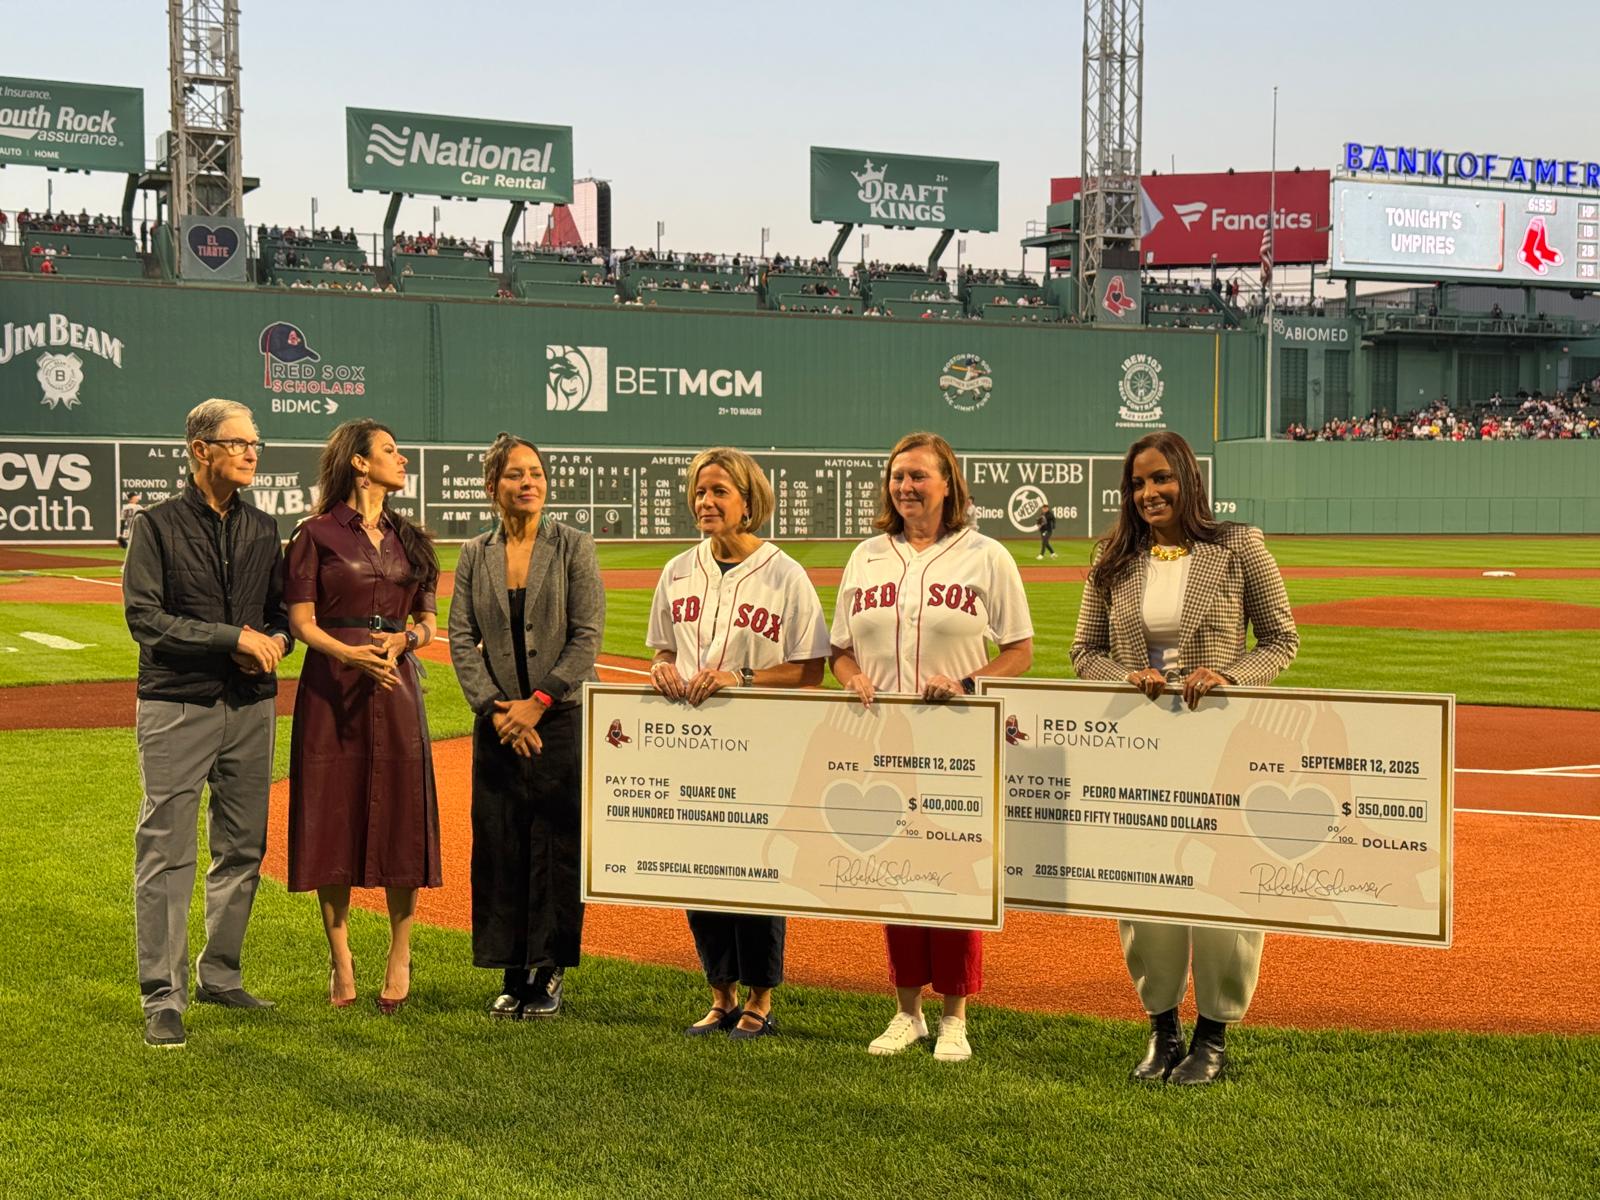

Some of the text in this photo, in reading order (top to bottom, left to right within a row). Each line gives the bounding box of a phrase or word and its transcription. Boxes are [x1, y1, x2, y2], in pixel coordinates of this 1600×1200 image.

[56, 106, 117, 134] Rock
[37, 130, 118, 147] assurance
[0, 148, 60, 159] AUTO HOME
[410, 131, 552, 173] National
[1345, 142, 1444, 178] BANK
[1456, 152, 1501, 180] OF
[461, 171, 547, 190] Car Rental
[858, 180, 948, 204] DRAFT
[870, 199, 946, 223] KINGS
[1528, 198, 1552, 212] 6:55
[1211, 207, 1312, 231] Fanatics
[1385, 208, 1463, 230] TONIGHT'S
[207, 235, 218, 246] EL
[1390, 233, 1456, 255] UMPIRES
[0, 313, 122, 369] JIM BEAM
[1284, 327, 1348, 342] ABIOMED
[1121, 354, 1162, 373] IBEW 103
[272, 363, 365, 381] RED SOX
[272, 380, 365, 396] SCHOLARS
[615, 366, 763, 398] BETMGM
[271, 399, 321, 414] BIDMC
[730, 407, 739, 416] TO
[740, 408, 762, 417] WAGER
[148, 448, 165, 458] AL
[178, 465, 187, 475] W
[443, 465, 630, 476] P 7 8 9 10 R H E
[825, 459, 873, 468] NATIONAL
[0, 452, 92, 491] CVS
[640, 467, 647, 476] P
[780, 469, 787, 478] P
[827, 469, 834, 478] R
[846, 470, 852, 478] P
[973, 462, 1084, 484] F.W. WEBB
[122, 478, 168, 489] TORONTO
[275, 475, 298, 487] BUT
[656, 480, 670, 488] CIN
[793, 481, 809, 490] COL
[858, 481, 874, 490] LAD
[146, 491, 171, 501] YORK
[453, 490, 487, 500] BOSTON
[655, 488, 671, 497] ATH
[861, 491, 871, 499] SF
[654, 498, 672, 507] CWS
[795, 499, 807, 508] PIT
[859, 500, 874, 509] TEX
[1017, 498, 1039, 518] WEBB
[1214, 501, 1237, 513] 379
[442, 511, 568, 521] AT BAT OUT
[654, 508, 672, 516] CLE
[792, 509, 810, 518] WSH
[858, 509, 874, 518] NYM
[976, 506, 1078, 519] Since 1866
[655, 517, 671, 526] BAL
[795, 518, 807, 526] KC
[858, 518, 874, 527] DET
[654, 527, 672, 535] TOR
[795, 526, 808, 535] PHI
[860, 526, 873, 535] MIA
[852, 582, 978, 616] RED SOX
[734, 603, 783, 643] SOX
[645, 722, 712, 736] RED SOX
[1043, 719, 1119, 734] RED SOX
[645, 736, 748, 752] FOUNDATION
[1043, 733, 1158, 750] FOUNDATION
[828, 755, 976, 772] DATE SEPTEMBER 12, 2025
[1249, 755, 1420, 775] DATE SEPTEMBER 12, 2025
[605, 775, 670, 788] PAY TO THE
[1027, 775, 1071, 787] TO THE
[613, 785, 737, 800] ORDER OF SQUARE ONE
[1009, 785, 1240, 807] ORDER OF PEDRO MARTINEZ FOUNDATION
[908, 797, 980, 813] $ 400,000.00
[1341, 801, 1424, 819] $ 350,000.00
[607, 804, 769, 825] FOUR HUNDRED THOUSAND DOLLARS
[1035, 806, 1218, 831] HUNDRED FIFTY THOUSAND DOLLARS
[926, 830, 983, 844] DOLLARS
[1362, 837, 1428, 852] DOLLARS
[605, 860, 779, 880] FOR 2025 SPECIAL RECOGNITION AWARD
[1035, 863, 1194, 887] 2025 SPECIAL RECOGNITION AWARD
